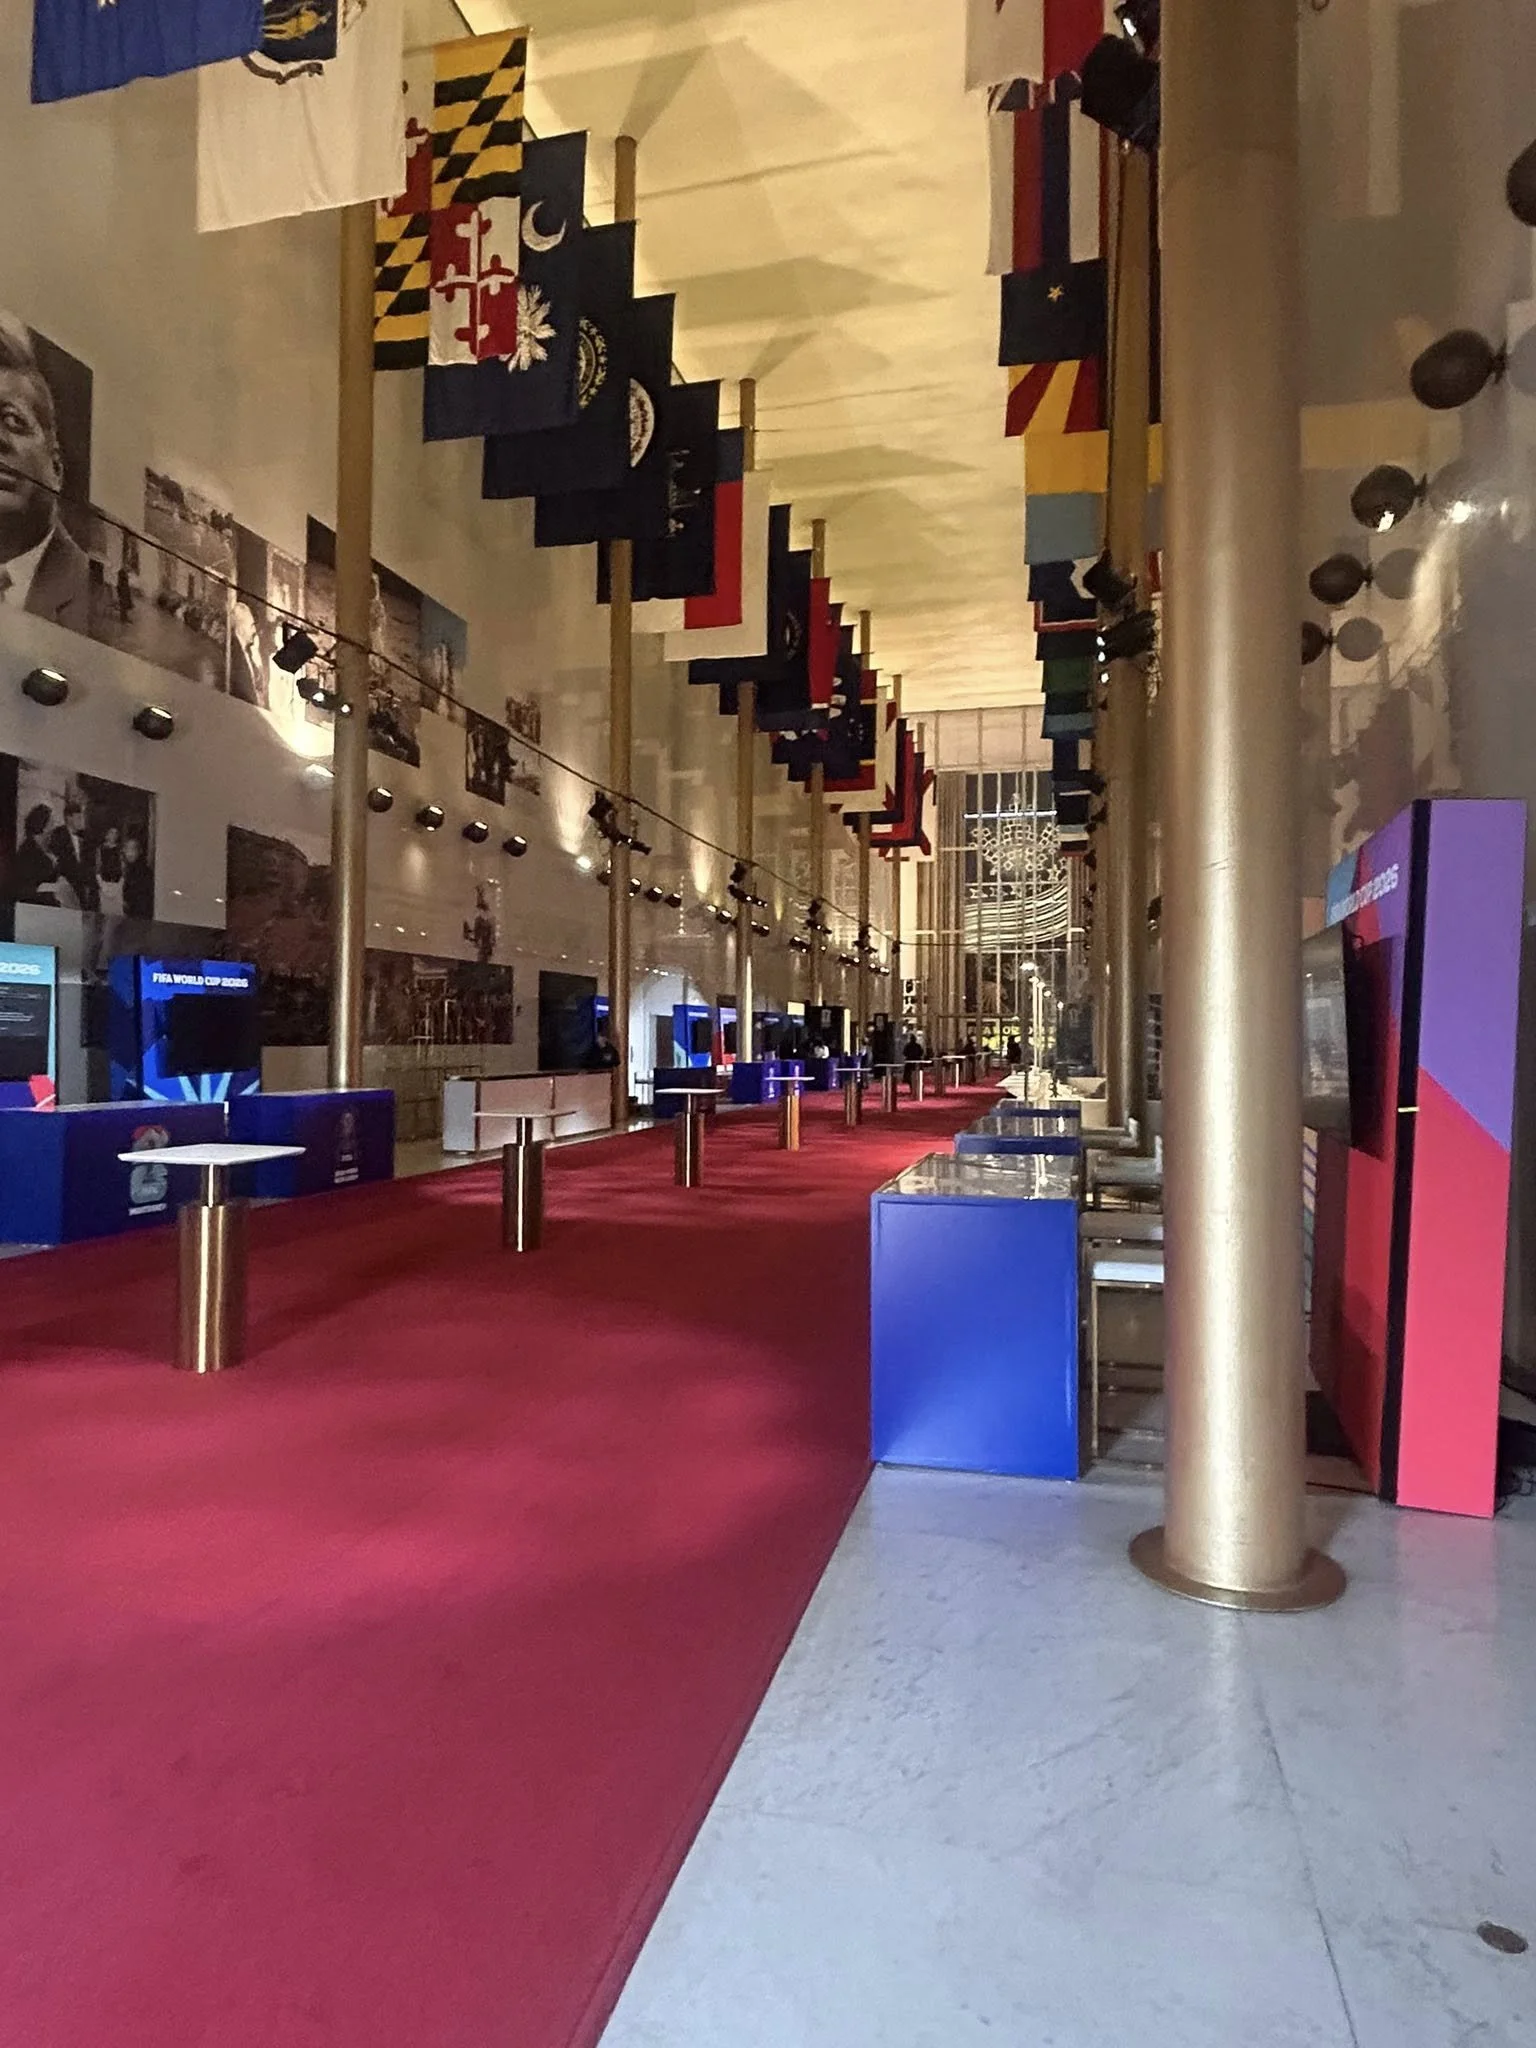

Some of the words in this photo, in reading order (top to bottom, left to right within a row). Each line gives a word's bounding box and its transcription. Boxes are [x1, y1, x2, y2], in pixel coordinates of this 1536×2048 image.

[0, 962, 41, 975] 2026
[152, 972, 173, 984] FIFA
[173, 974, 204, 986] WORLD
[205, 976, 221, 986] CUP
[221, 977, 249, 988] 2026
